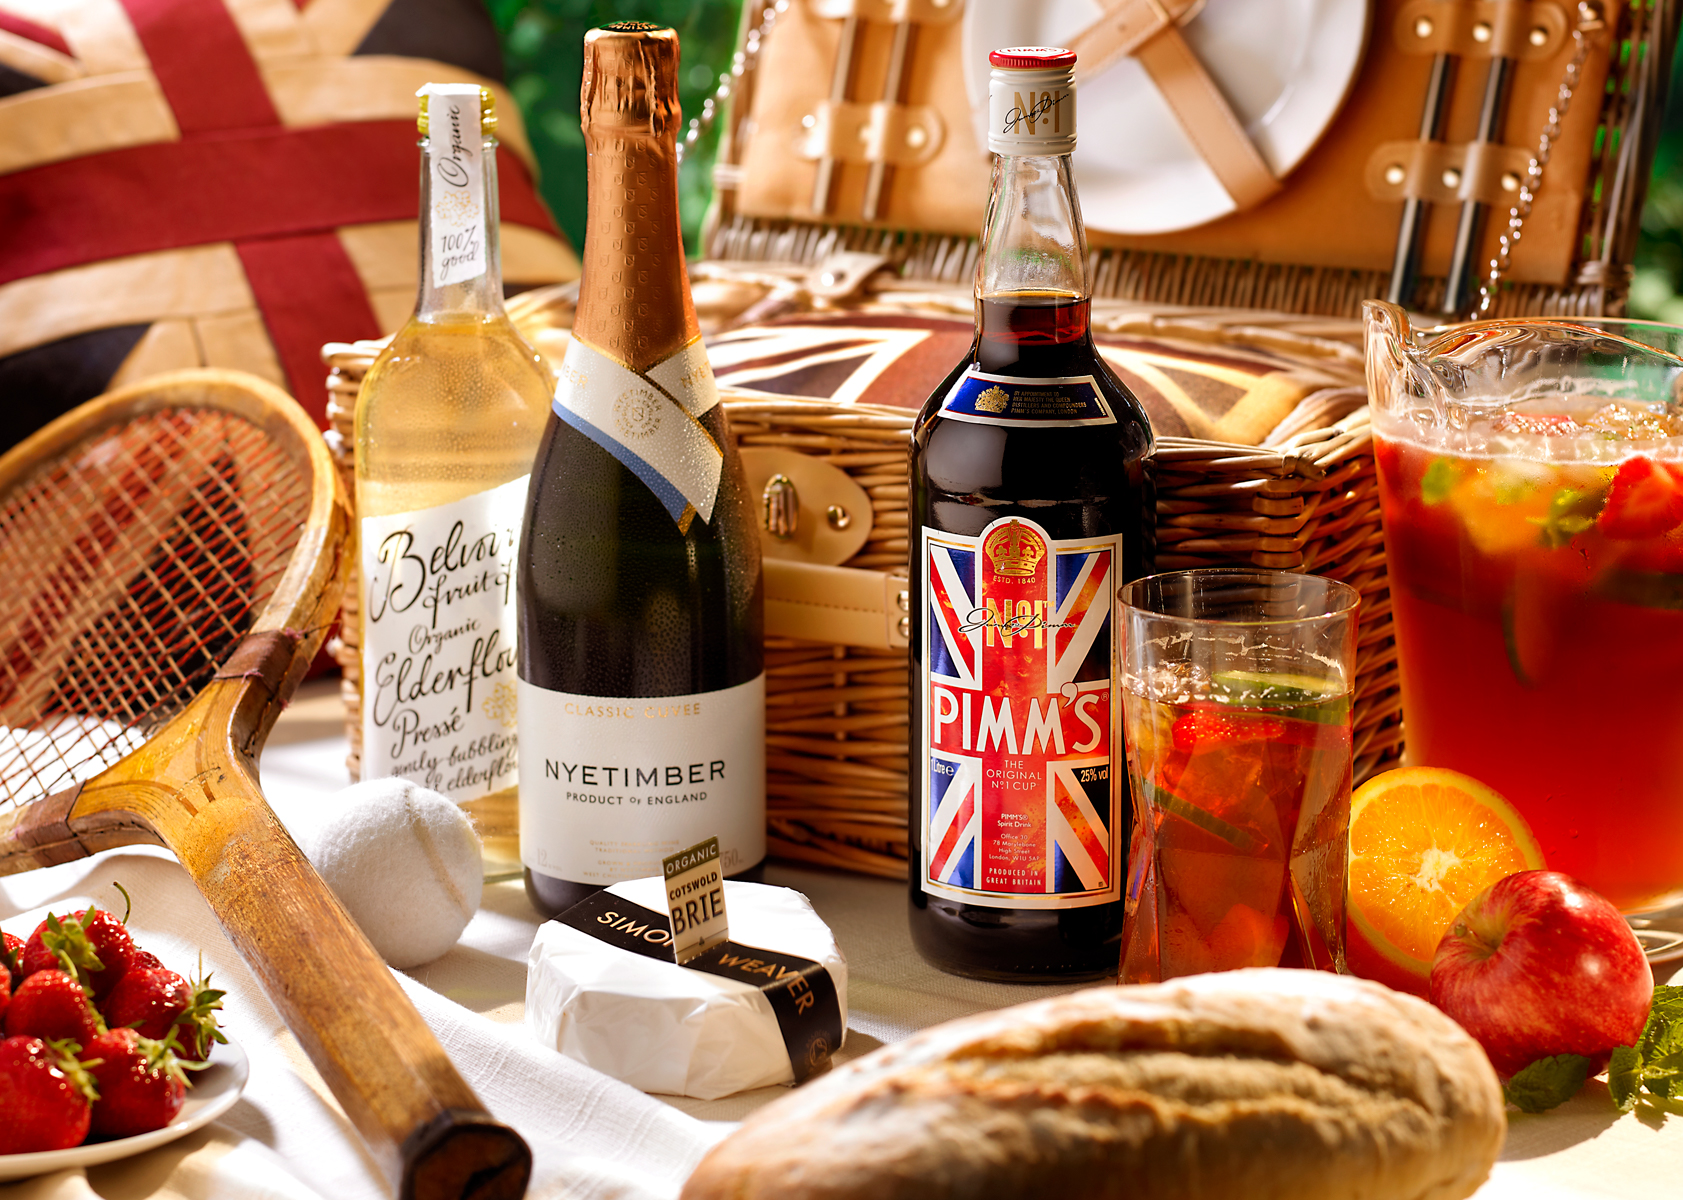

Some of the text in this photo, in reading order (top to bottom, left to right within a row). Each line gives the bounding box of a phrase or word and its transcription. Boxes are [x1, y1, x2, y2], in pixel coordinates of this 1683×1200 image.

[437, 105, 473, 187] Organic
[441, 225, 476, 253] 100%
[440, 241, 479, 281] good
[1017, 576, 1036, 584] 1840
[422, 571, 492, 629] fruit
[409, 624, 481, 654] Organic
[564, 702, 701, 719] CLASSIC CUVEE
[390, 706, 465, 759] Pressé
[1004, 759, 1024, 770] THE
[545, 758, 726, 788] NYETIMBER
[986, 768, 1043, 781] ORIGINAL
[1080, 767, 1109, 783] 25% vol
[1013, 780, 1037, 791] CUP
[566, 791, 624, 805] PRODUCT
[647, 791, 708, 806] ENGLAND
[997, 820, 1013, 828] Spirit
[999, 847, 1012, 855] High
[1002, 840, 1036, 848] Marylebone
[666, 843, 717, 874] ORGANIC
[988, 853, 1011, 861] London,
[988, 867, 1026, 876] PRODUCED
[669, 871, 718, 901] COTSWOLD
[986, 876, 1041, 886] GREAT BRITAIN
[671, 887, 724, 935] BRIE
[718, 953, 815, 1016] WEAVER
